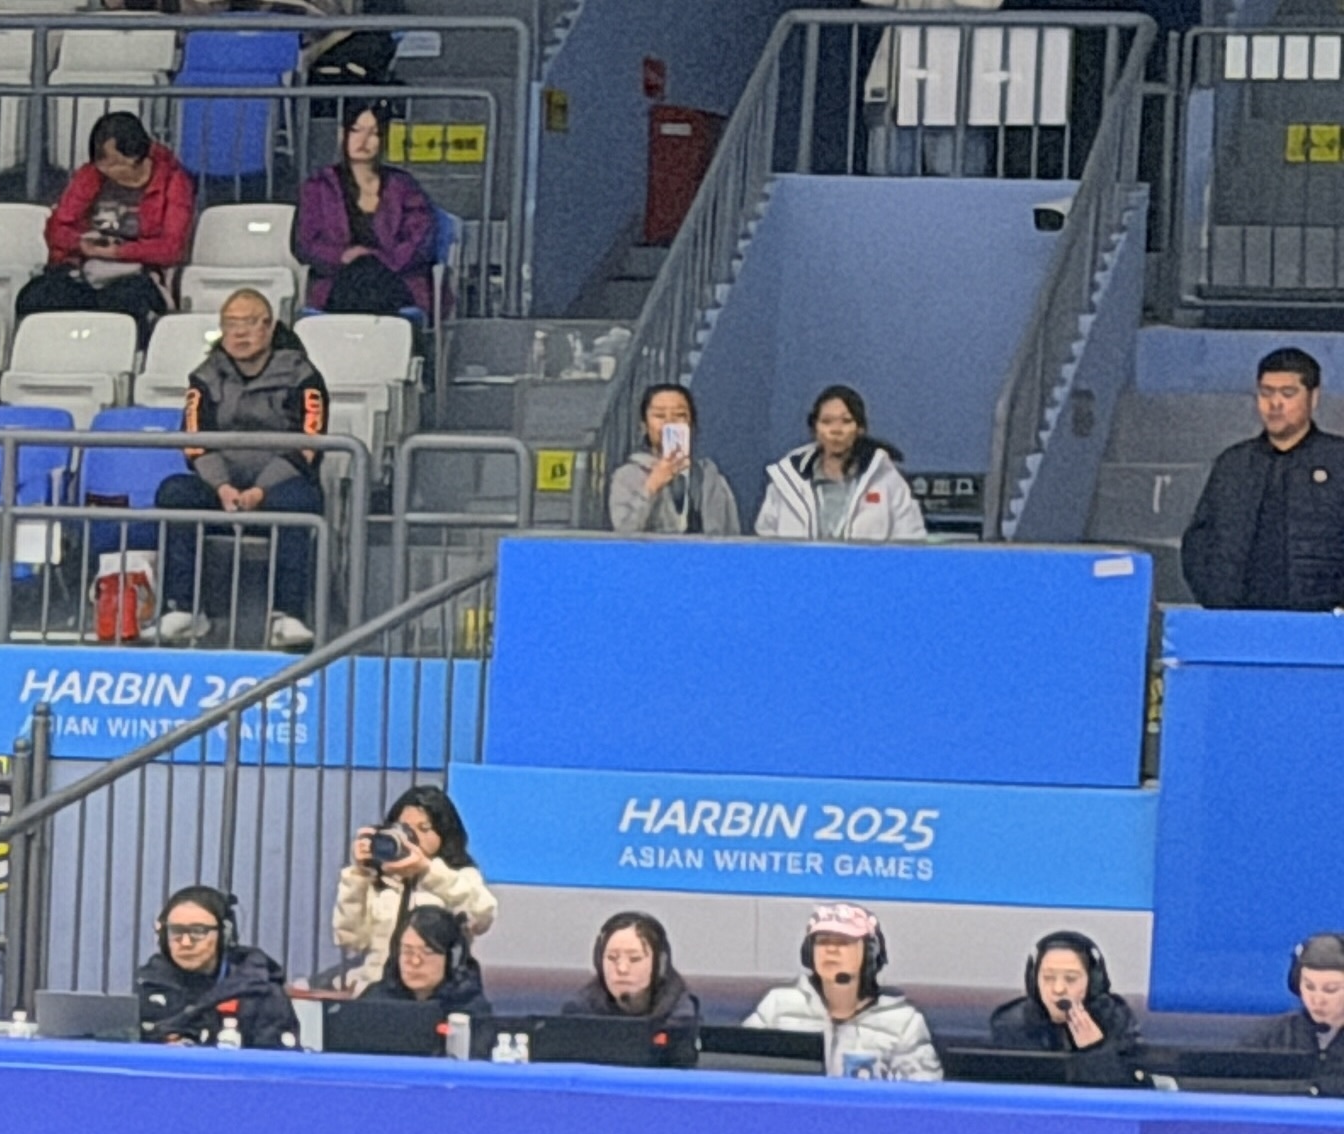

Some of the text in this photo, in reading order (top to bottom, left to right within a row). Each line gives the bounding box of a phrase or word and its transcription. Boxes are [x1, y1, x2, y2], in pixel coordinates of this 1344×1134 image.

[20, 668, 192, 708] HARBIN
[618, 798, 940, 852] HARBIN 2025
[619, 846, 934, 881] ASIAN WINTER GAMES
